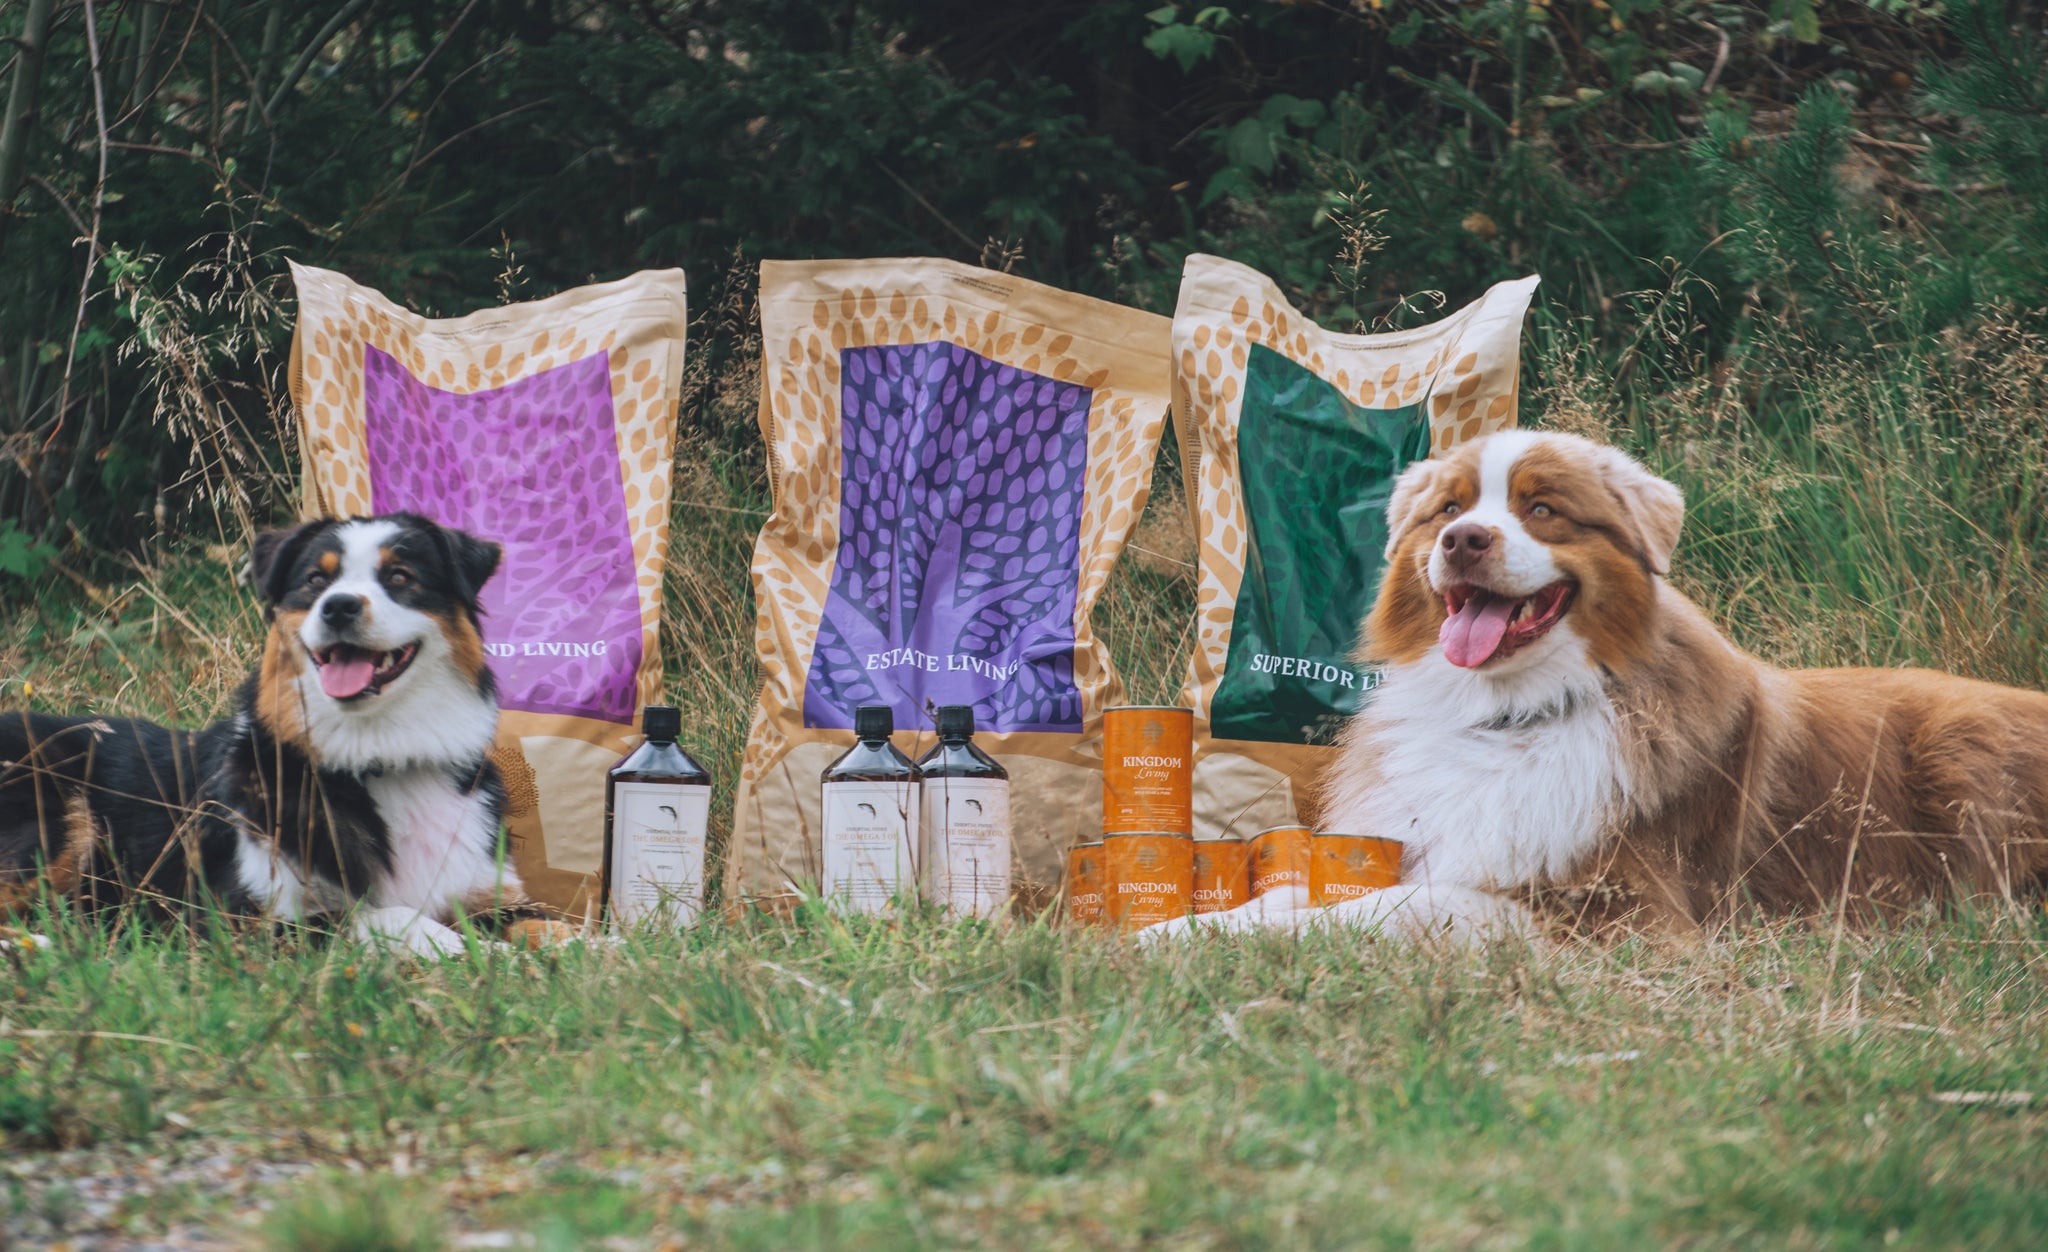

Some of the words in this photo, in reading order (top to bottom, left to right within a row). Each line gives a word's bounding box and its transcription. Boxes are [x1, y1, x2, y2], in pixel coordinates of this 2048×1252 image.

[523, 640, 608, 658] LIVING
[865, 647, 940, 672] ESTATE
[946, 654, 1019, 681] LIVING
[1250, 653, 1355, 689] SUPERIOR
[1361, 667, 1389, 691] LIV
[1123, 756, 1182, 768] KINGDOM
[1134, 767, 1169, 782] Living
[1118, 882, 1177, 894] KINGDOM
[1251, 870, 1301, 893] INGDOM
[1193, 889, 1233, 900] GDOM
[1325, 883, 1378, 896] KINGDO
[1129, 893, 1164, 908] Living
